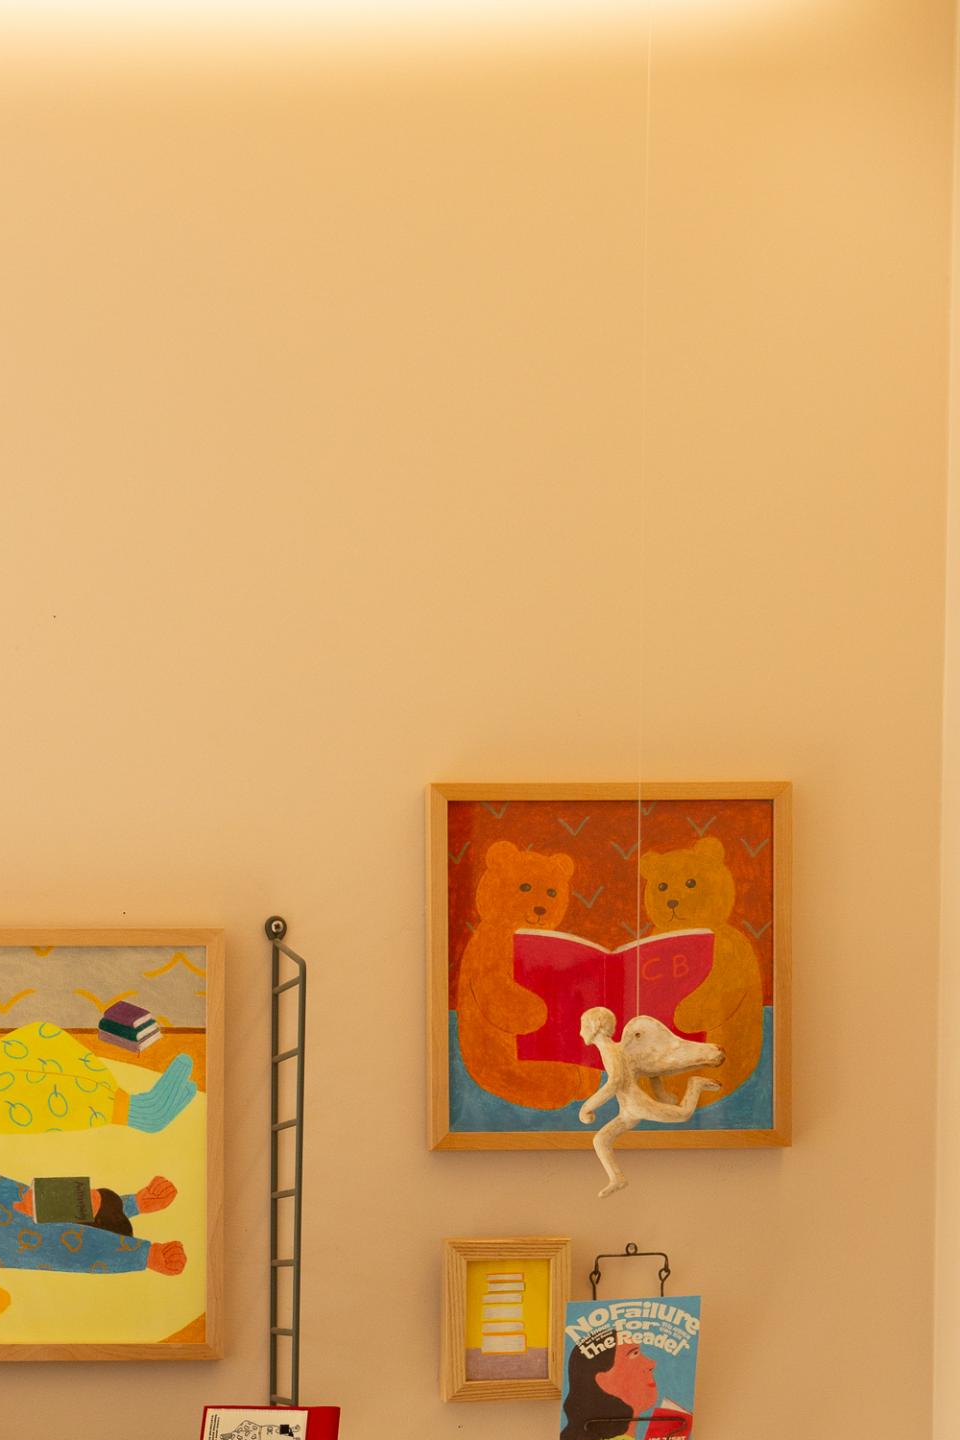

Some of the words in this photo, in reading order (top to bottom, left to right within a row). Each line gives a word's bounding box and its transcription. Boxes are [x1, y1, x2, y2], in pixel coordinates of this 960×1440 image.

[609, 1301, 700, 1335] Failure
[614, 1319, 660, 1331] for
[580, 1336, 616, 1359] the
[616, 1330, 690, 1356] Reader
